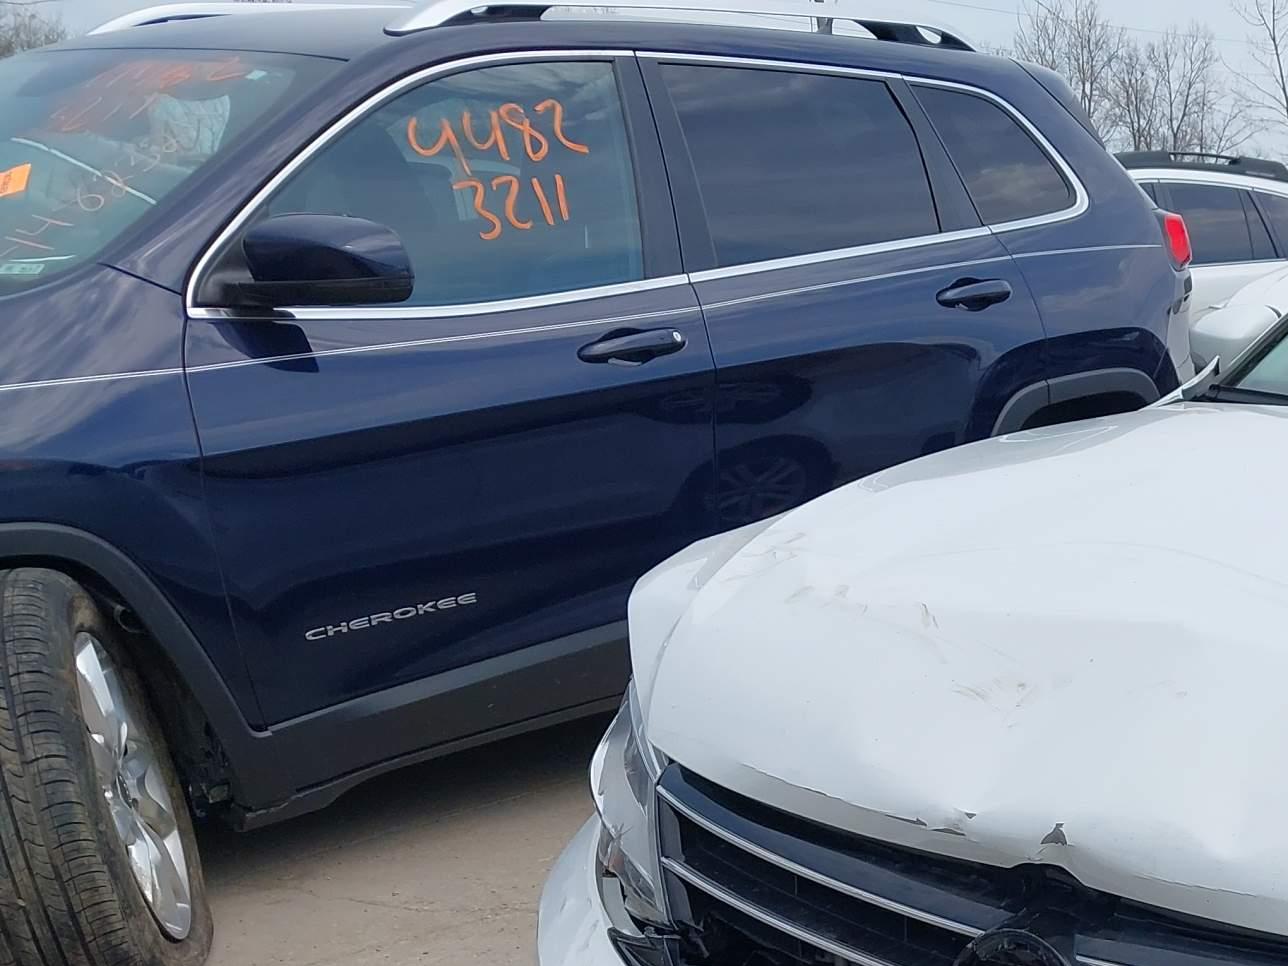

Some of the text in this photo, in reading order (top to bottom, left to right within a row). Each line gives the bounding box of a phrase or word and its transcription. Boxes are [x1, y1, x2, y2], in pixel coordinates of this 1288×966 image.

[407, 99, 590, 176] 4482
[452, 174, 571, 241] 3211
[304, 592, 478, 641] CHEROKEE
